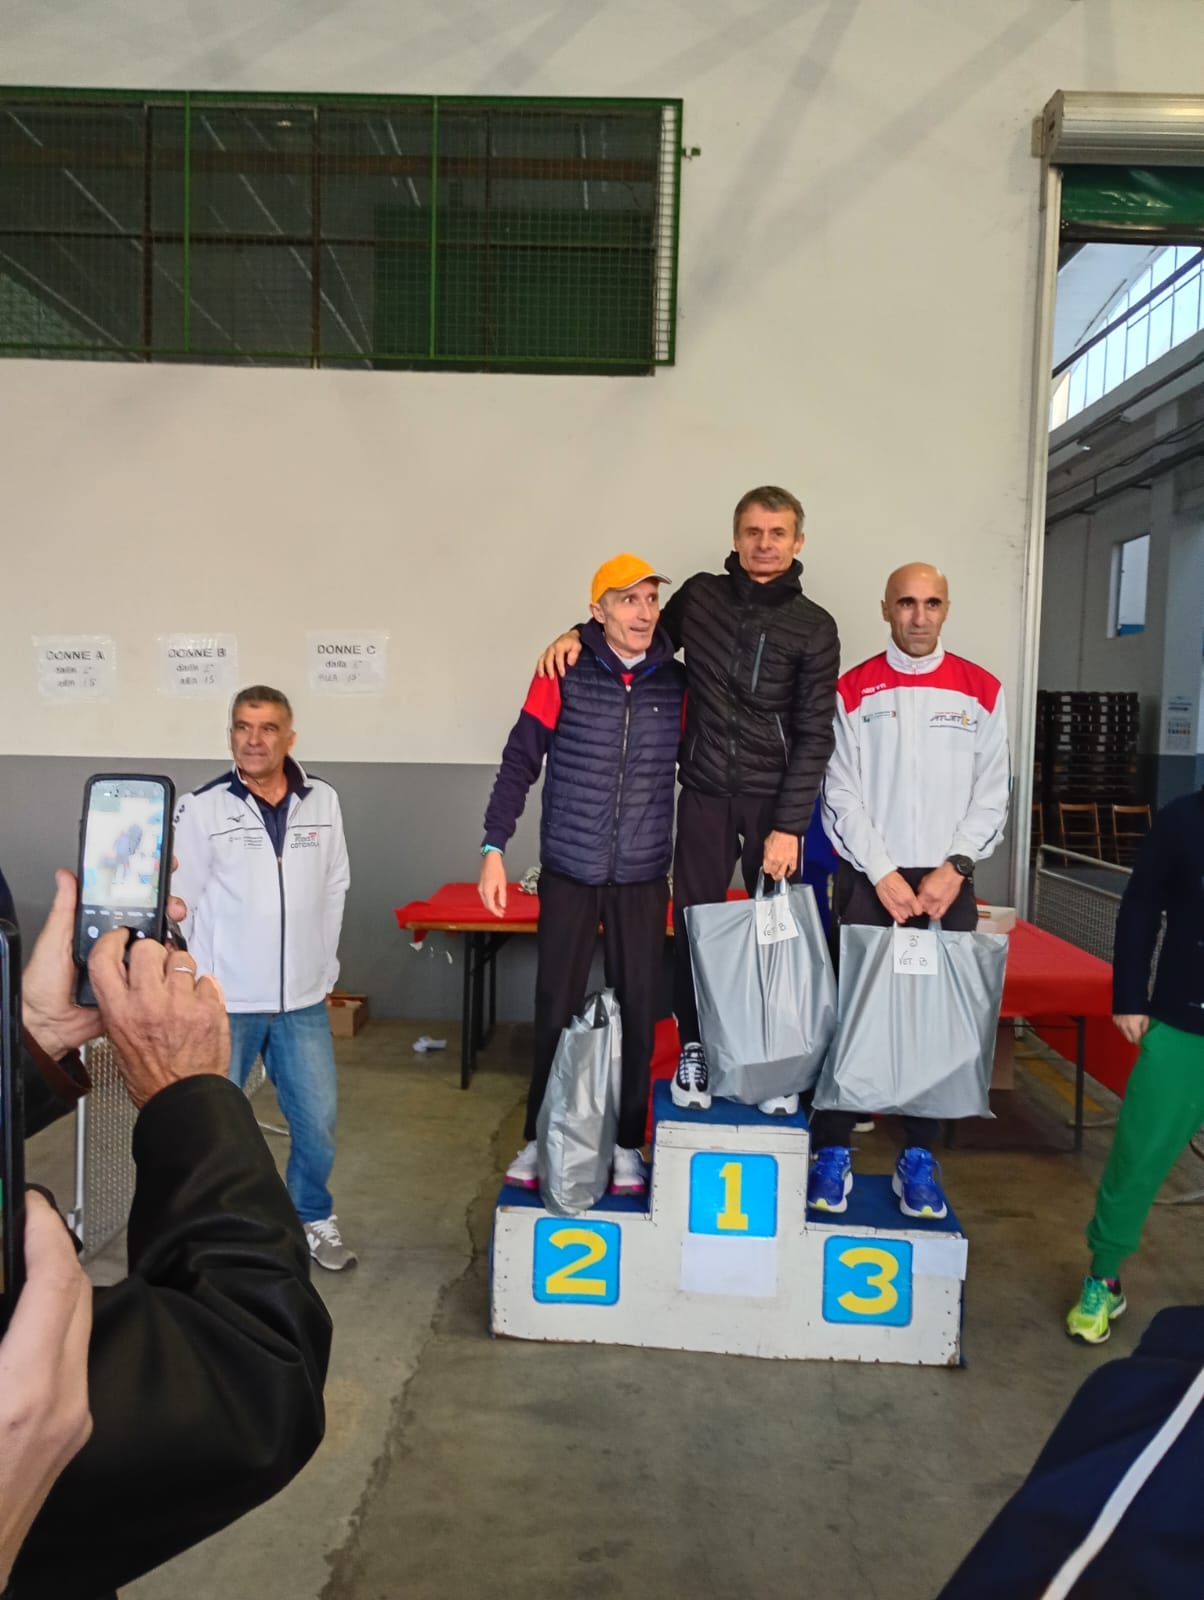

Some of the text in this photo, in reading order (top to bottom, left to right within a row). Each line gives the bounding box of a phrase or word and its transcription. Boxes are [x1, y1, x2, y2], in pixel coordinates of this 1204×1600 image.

[46, 650, 105, 660] DONNE A
[168, 648, 226, 658] DONNE B
[317, 644, 376, 655] DONNE C
[716, 1162, 750, 1231] 1
[546, 1228, 608, 1297] 2
[837, 1247, 900, 1315] 3
